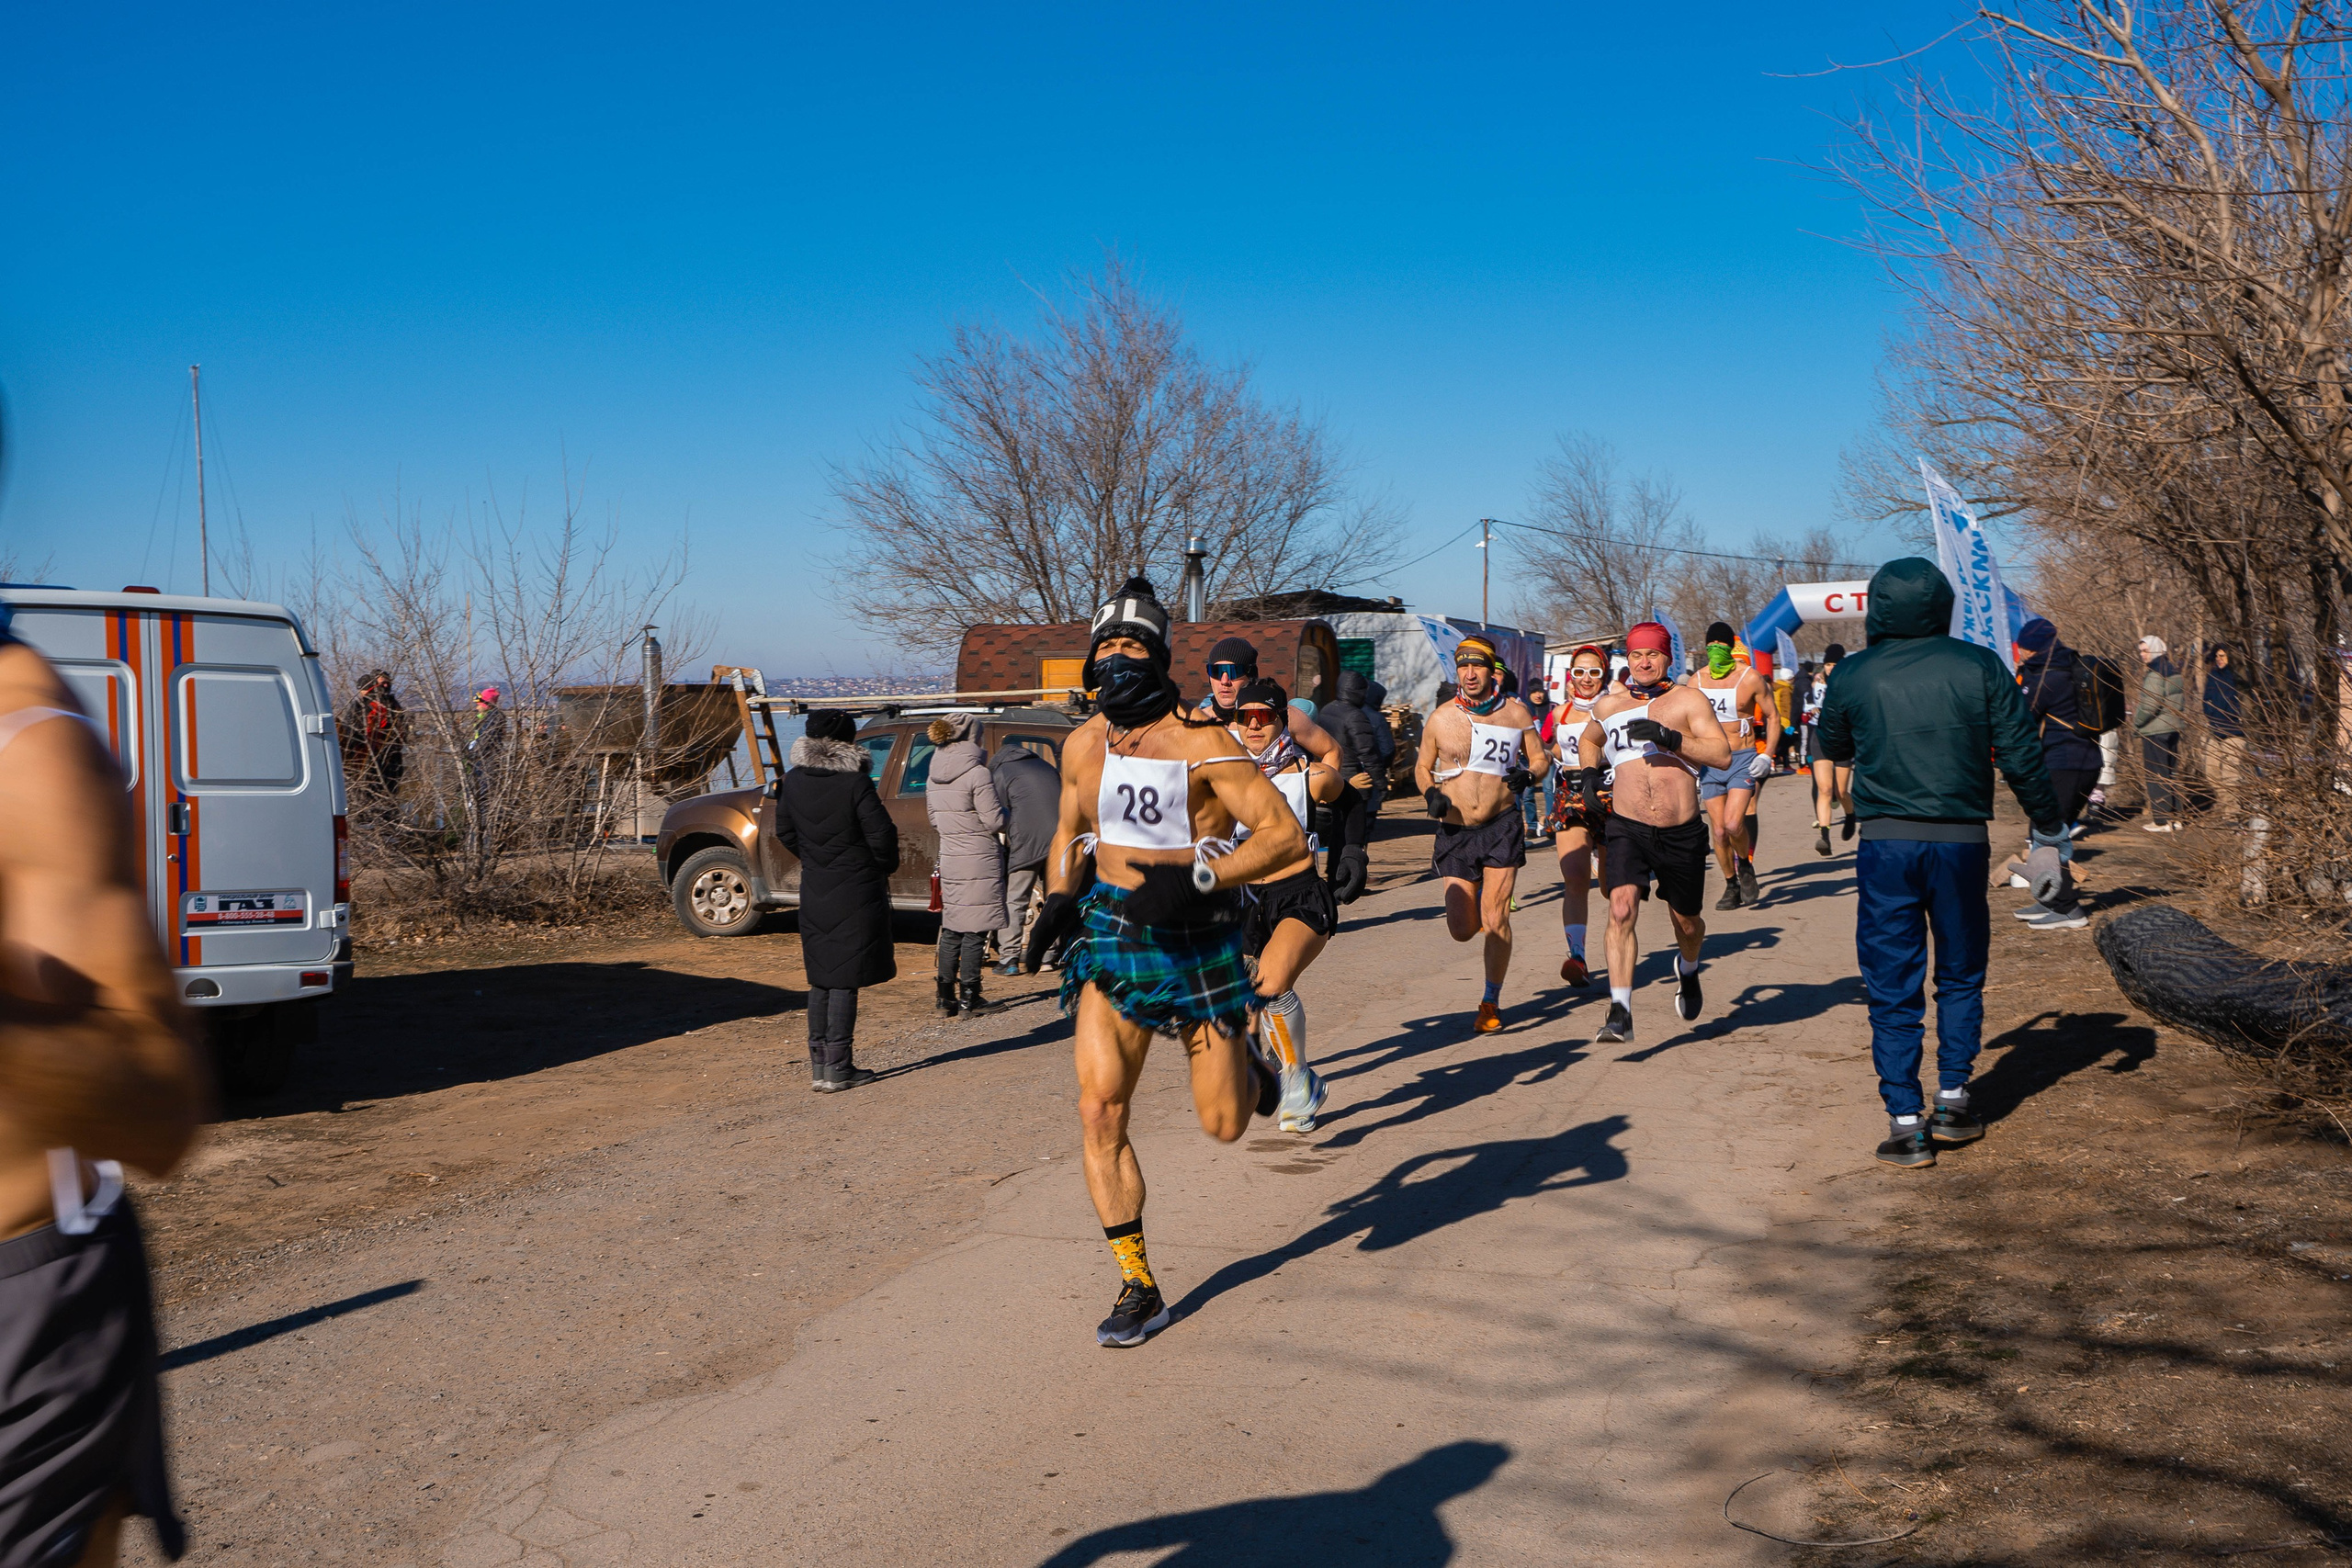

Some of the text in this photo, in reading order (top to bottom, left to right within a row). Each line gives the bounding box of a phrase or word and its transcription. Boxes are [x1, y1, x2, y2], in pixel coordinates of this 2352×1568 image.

[1825, 592, 1869, 613] СТ
[1483, 738, 1511, 763] 25
[1116, 783, 1163, 826] 28
[218, 898, 275, 911] ГАЗ
